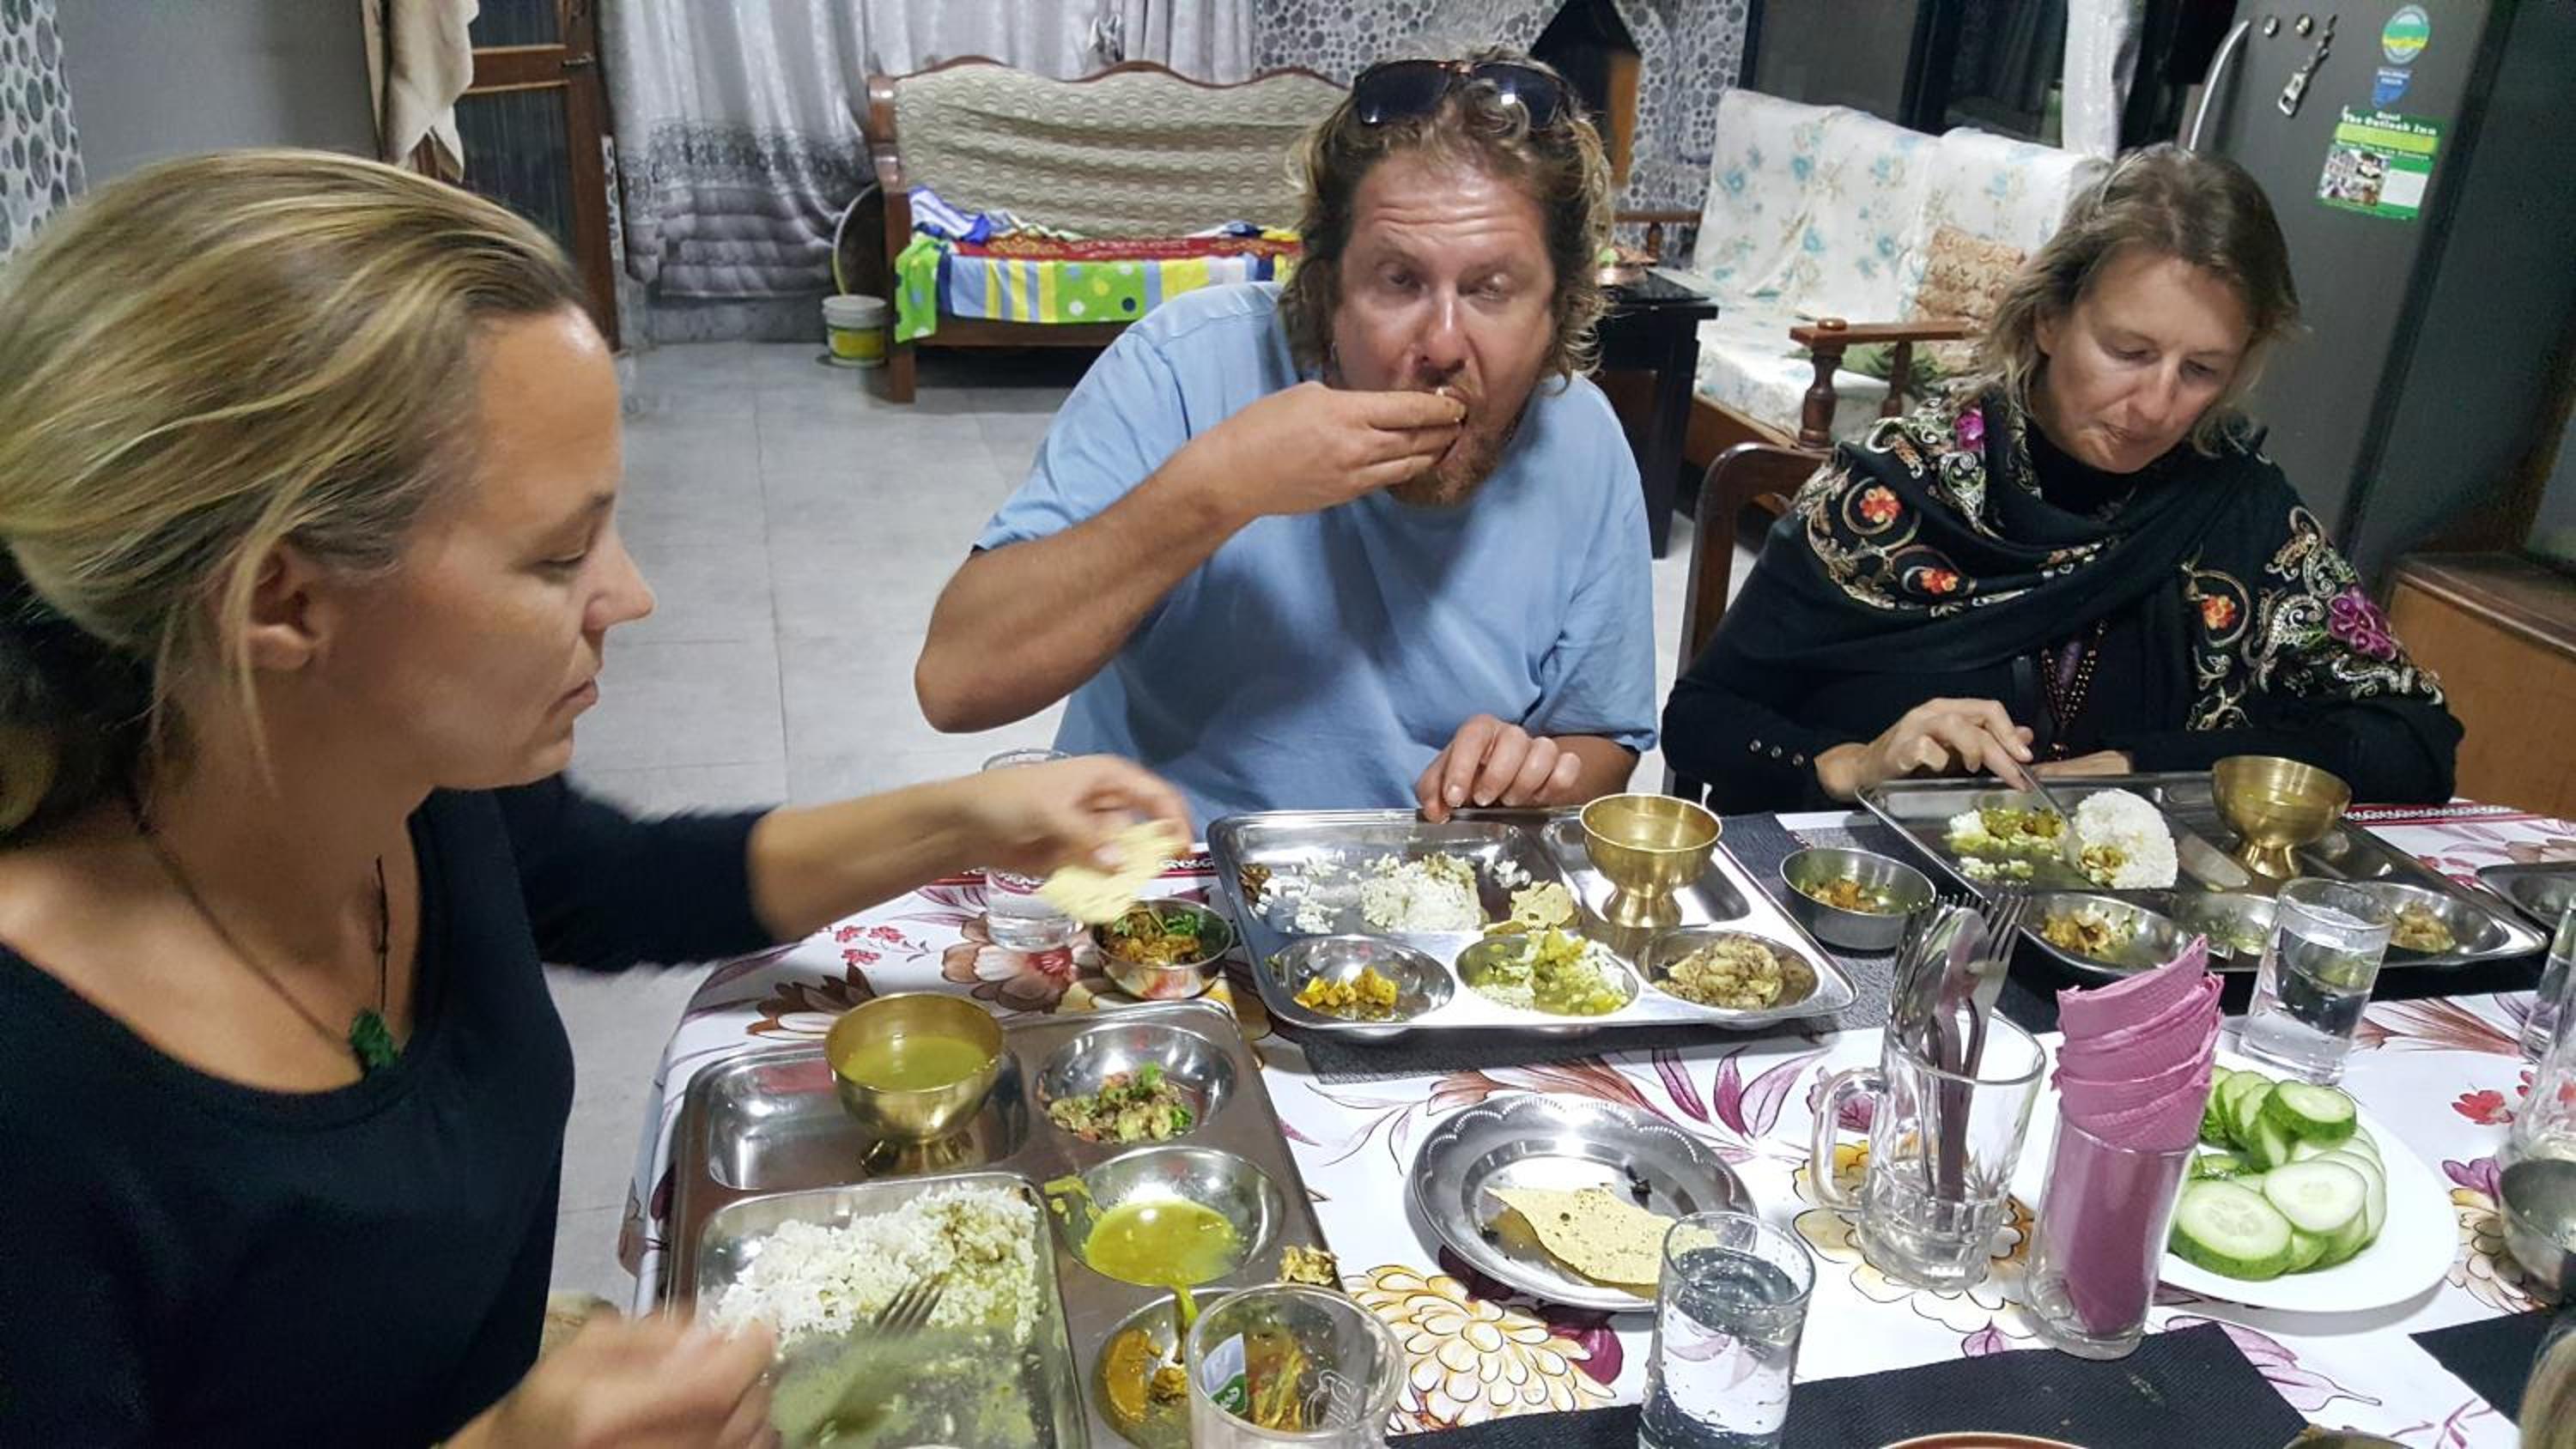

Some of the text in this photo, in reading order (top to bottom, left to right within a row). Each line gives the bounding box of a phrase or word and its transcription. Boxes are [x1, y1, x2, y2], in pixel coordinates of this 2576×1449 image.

[2342, 112, 2437, 136] The Outlook Inn
